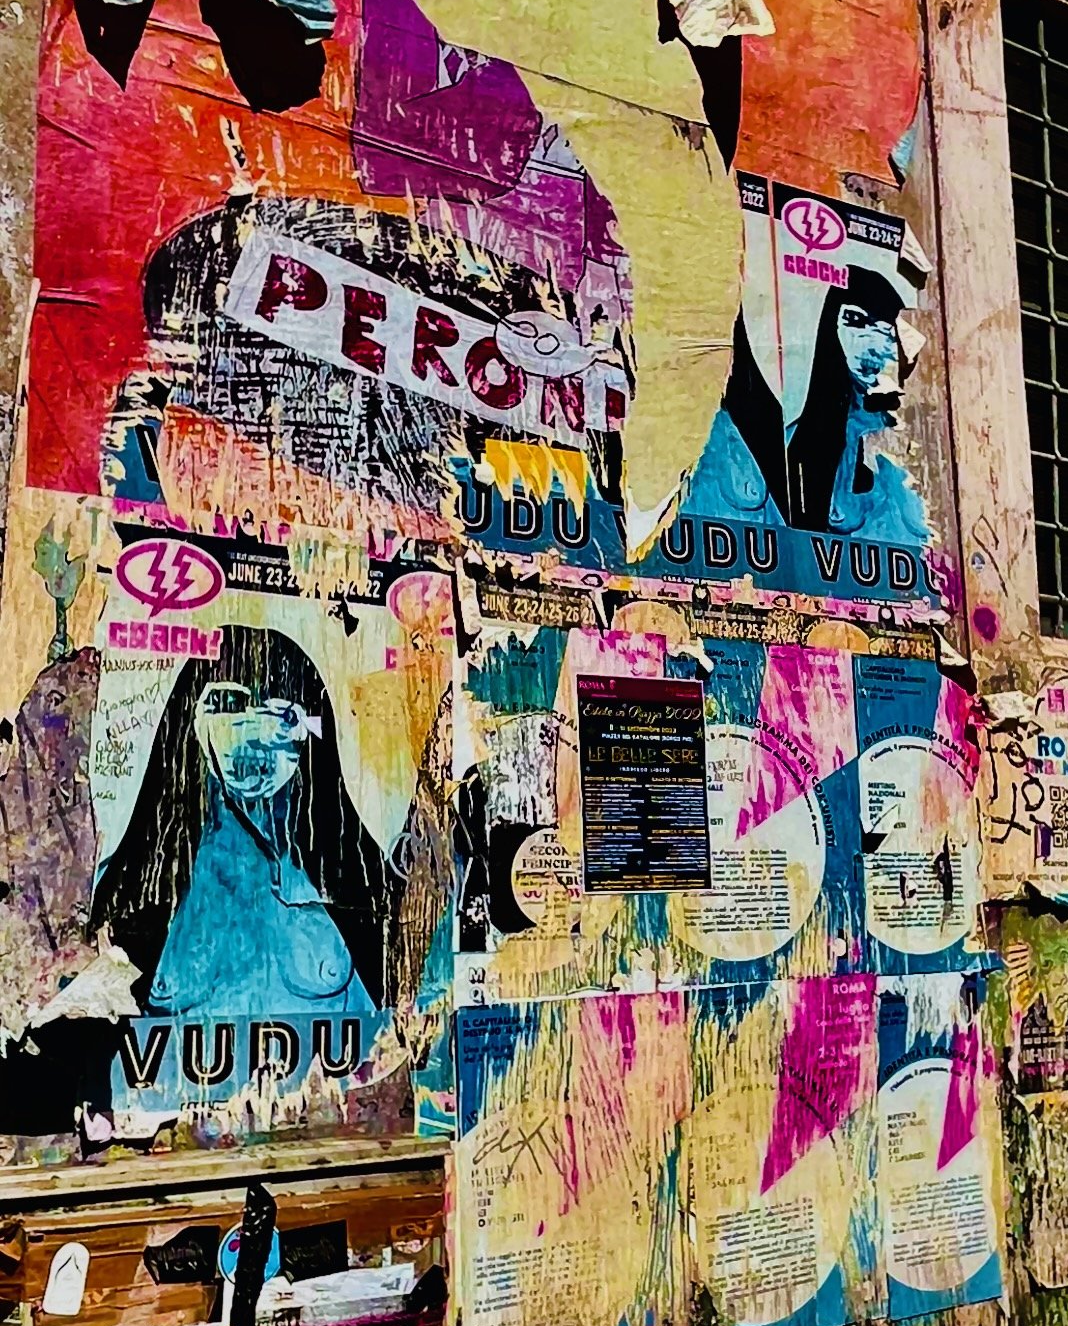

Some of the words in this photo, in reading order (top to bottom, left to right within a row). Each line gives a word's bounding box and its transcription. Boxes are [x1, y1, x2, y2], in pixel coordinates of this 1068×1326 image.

[848, 220, 868, 239] JUNE
[228, 562, 262, 585] JUNE
[108, 620, 223, 660] CRACK!
[832, 982, 867, 995] ROMA
[117, 1016, 363, 1090] VUDU
